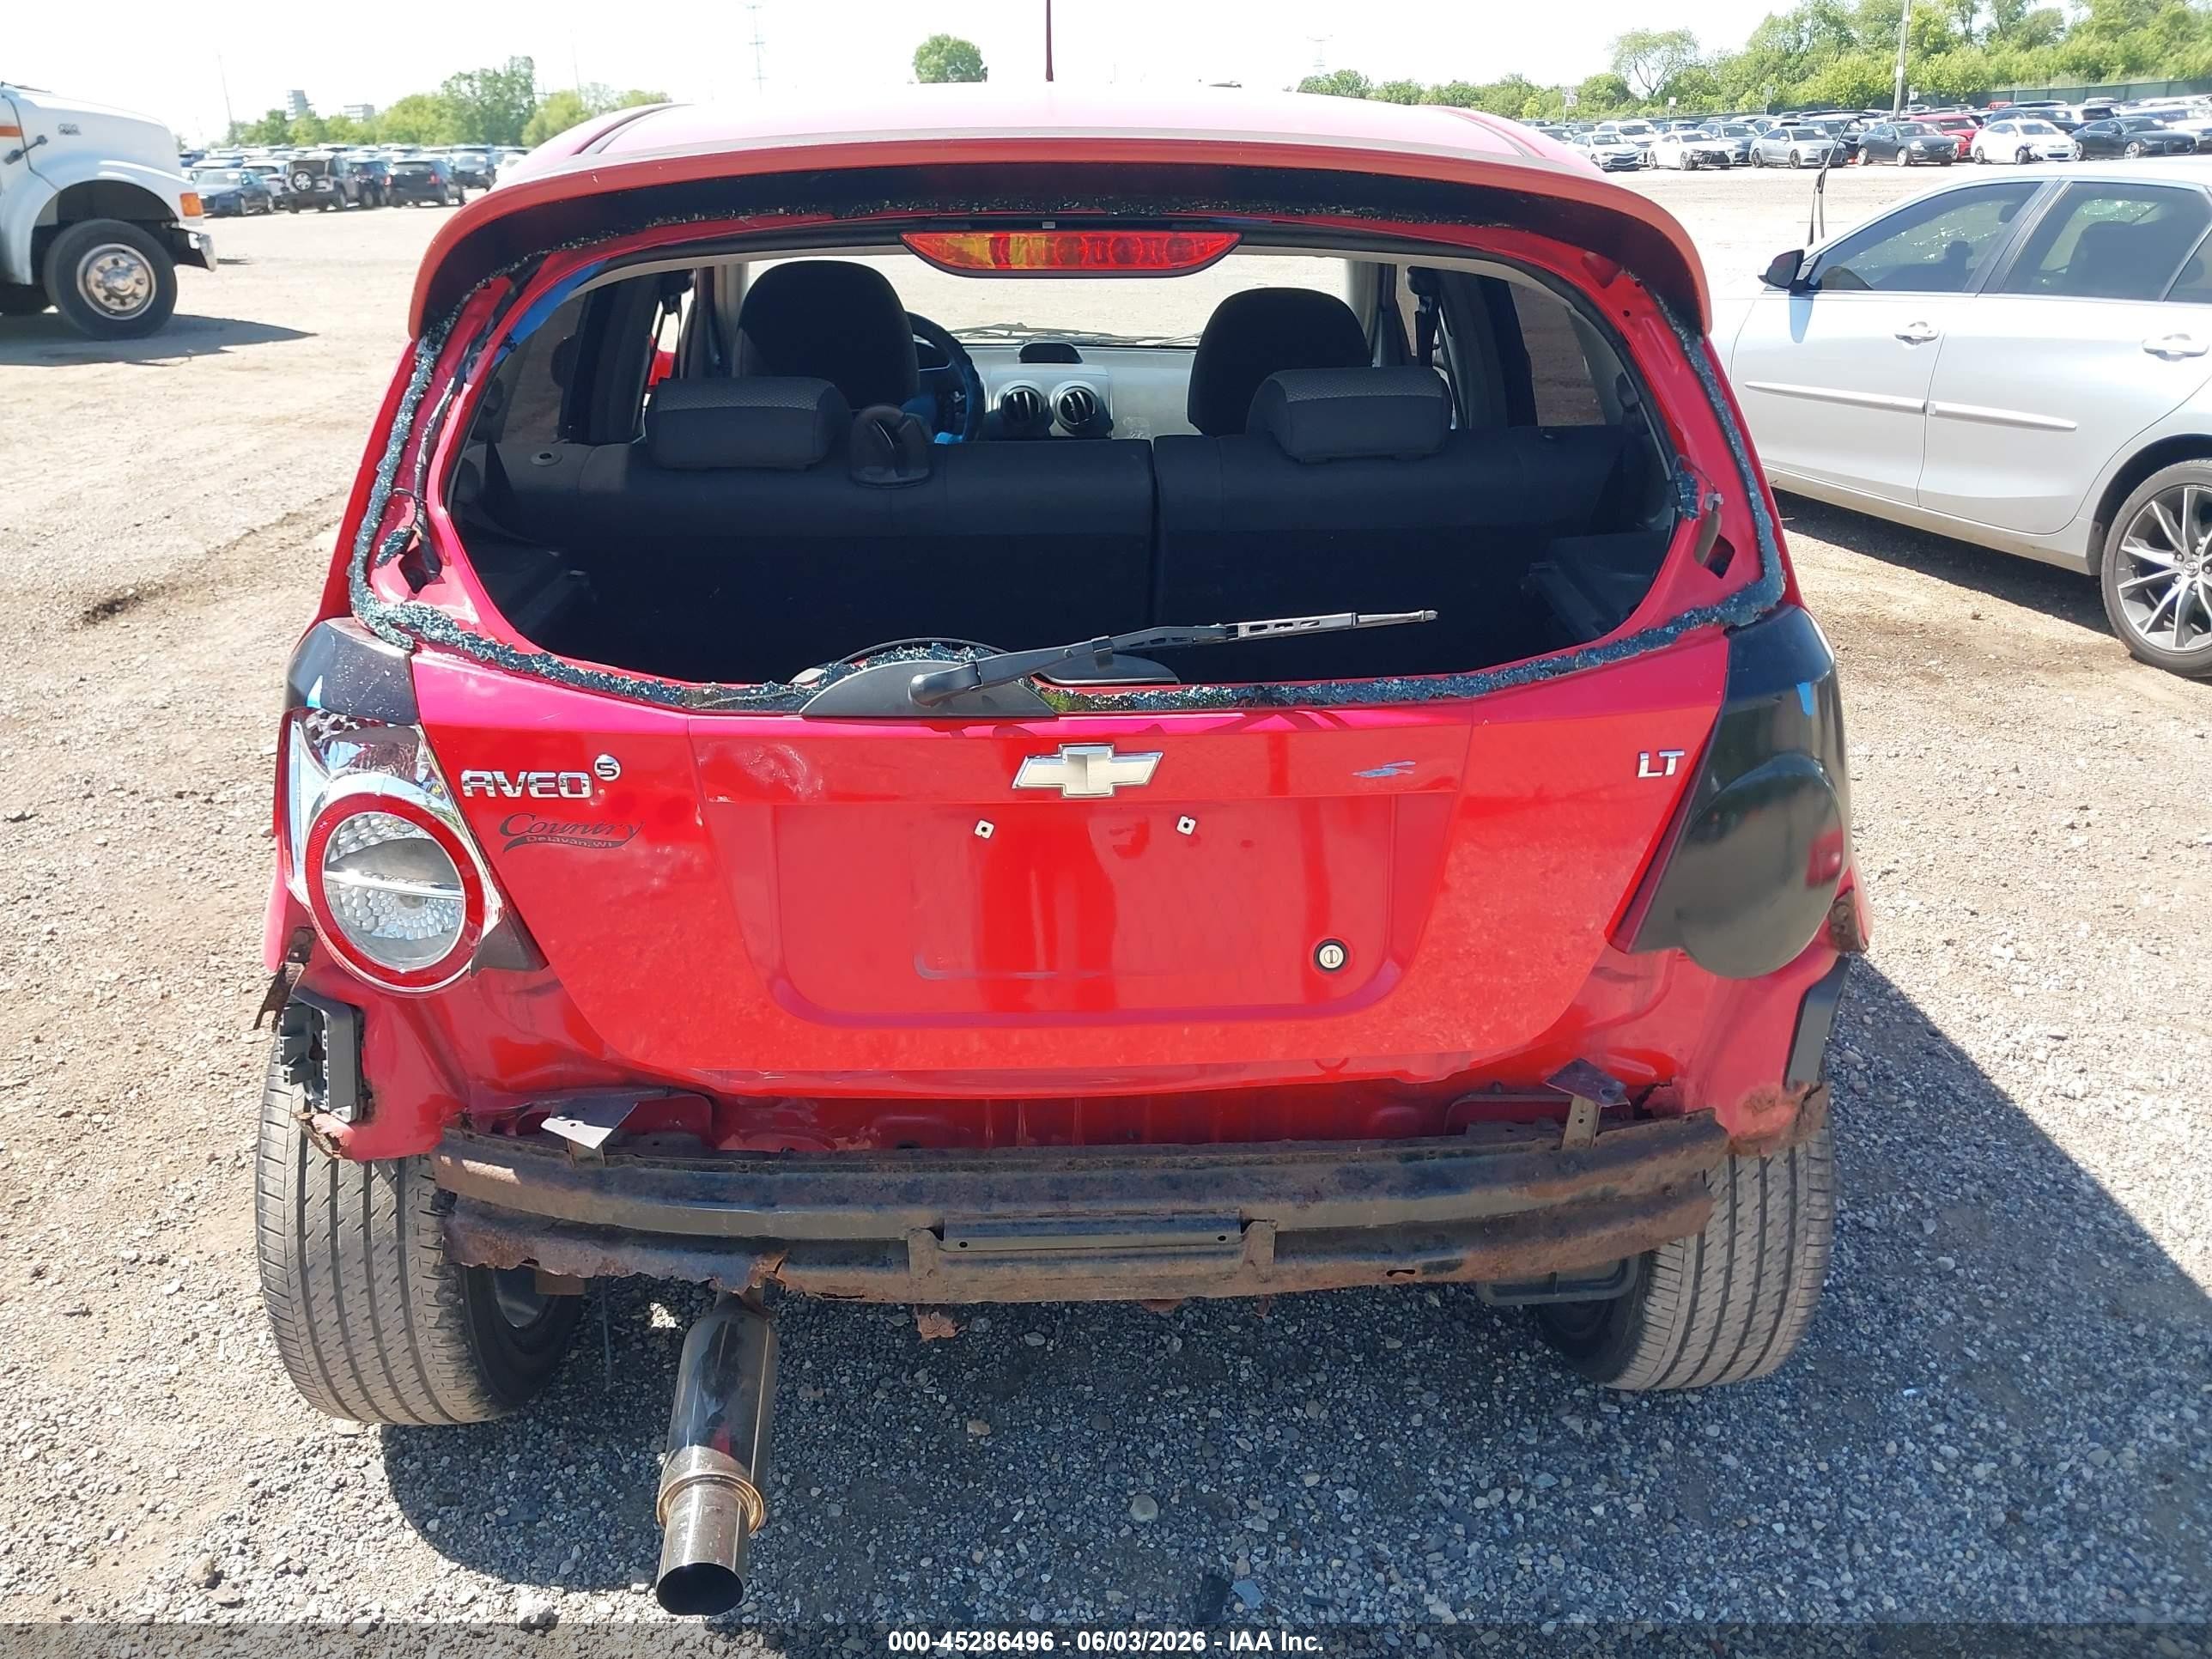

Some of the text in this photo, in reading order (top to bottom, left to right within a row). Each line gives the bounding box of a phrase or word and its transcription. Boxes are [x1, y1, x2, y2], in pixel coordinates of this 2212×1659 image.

[1638, 750, 1686, 777] LT
[461, 770, 592, 799] AVEO
[500, 812, 643, 841] Country
